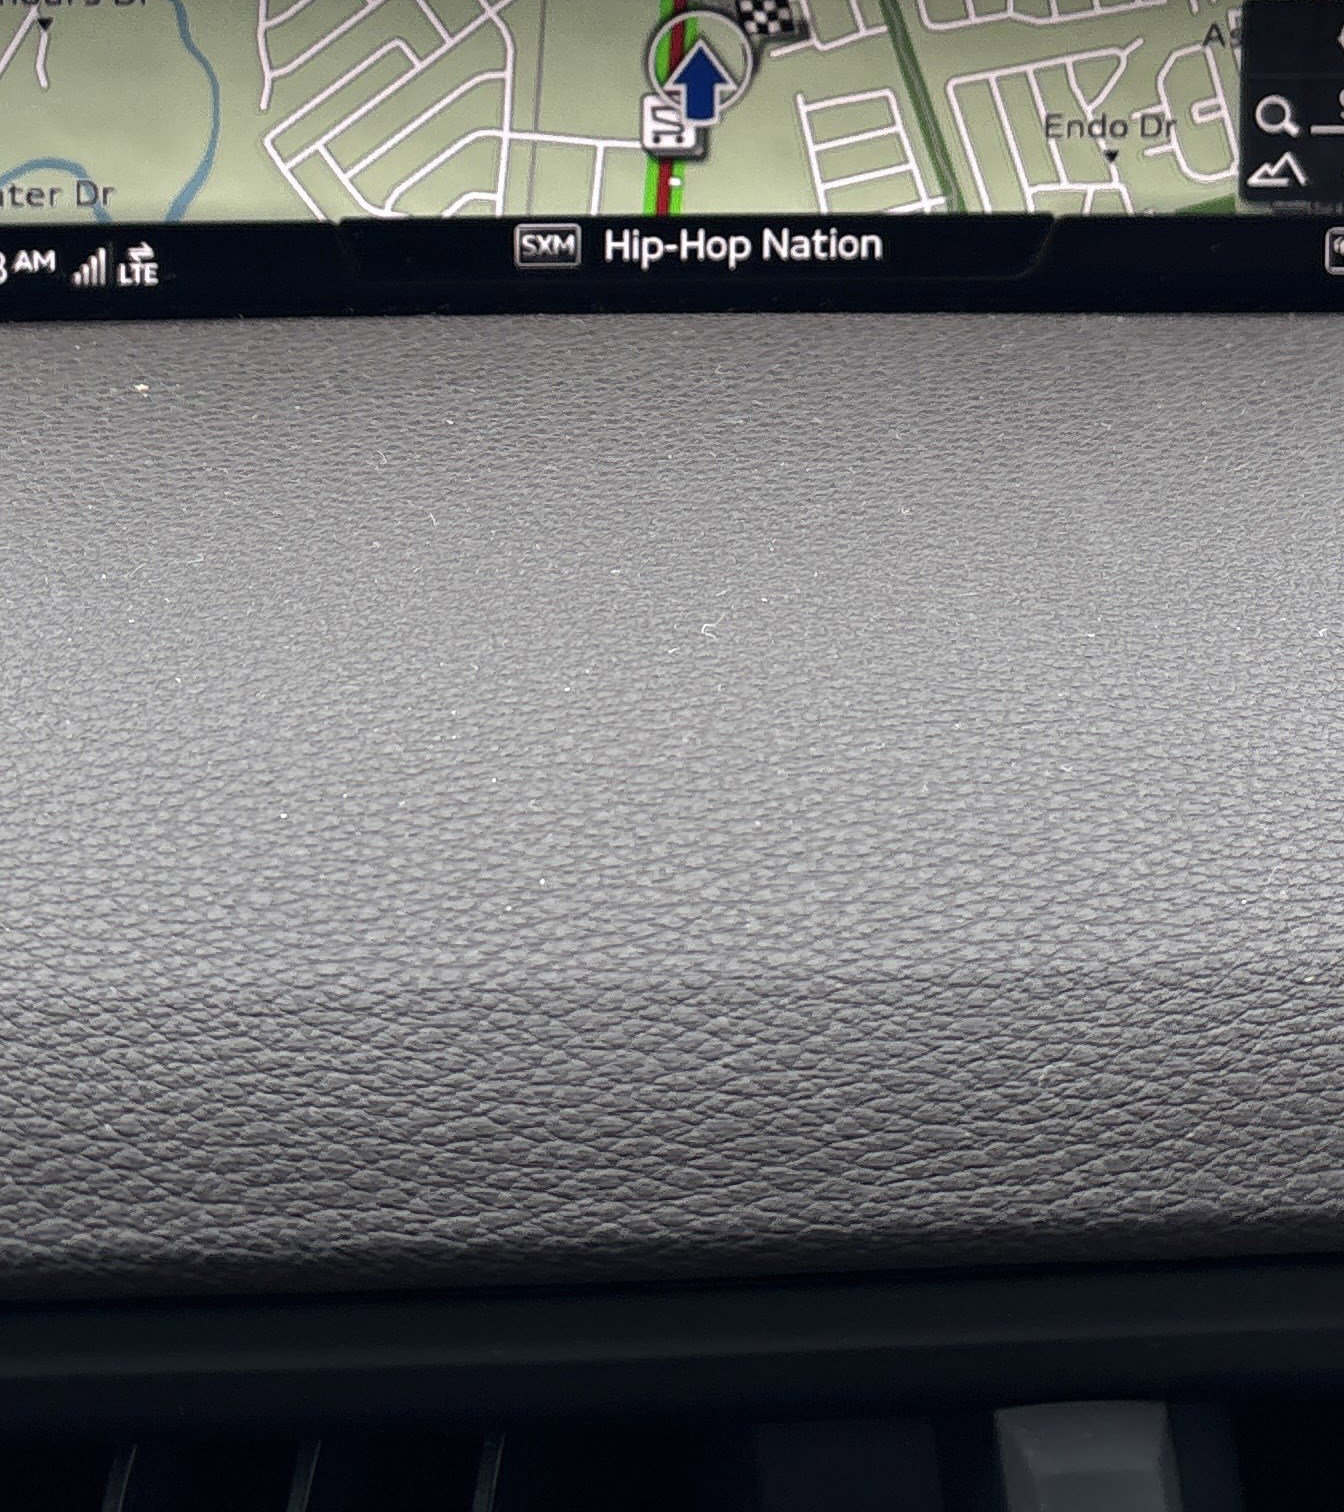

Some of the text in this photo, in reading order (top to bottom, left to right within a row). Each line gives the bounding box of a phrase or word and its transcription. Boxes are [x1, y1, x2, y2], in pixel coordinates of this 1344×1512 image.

[1044, 112, 1178, 140] Endo Dr
[76, 179, 115, 207] Dr
[521, 233, 576, 256] SXM
[604, 227, 884, 269] Hip-Hop Nation
[117, 262, 159, 288] LTE
